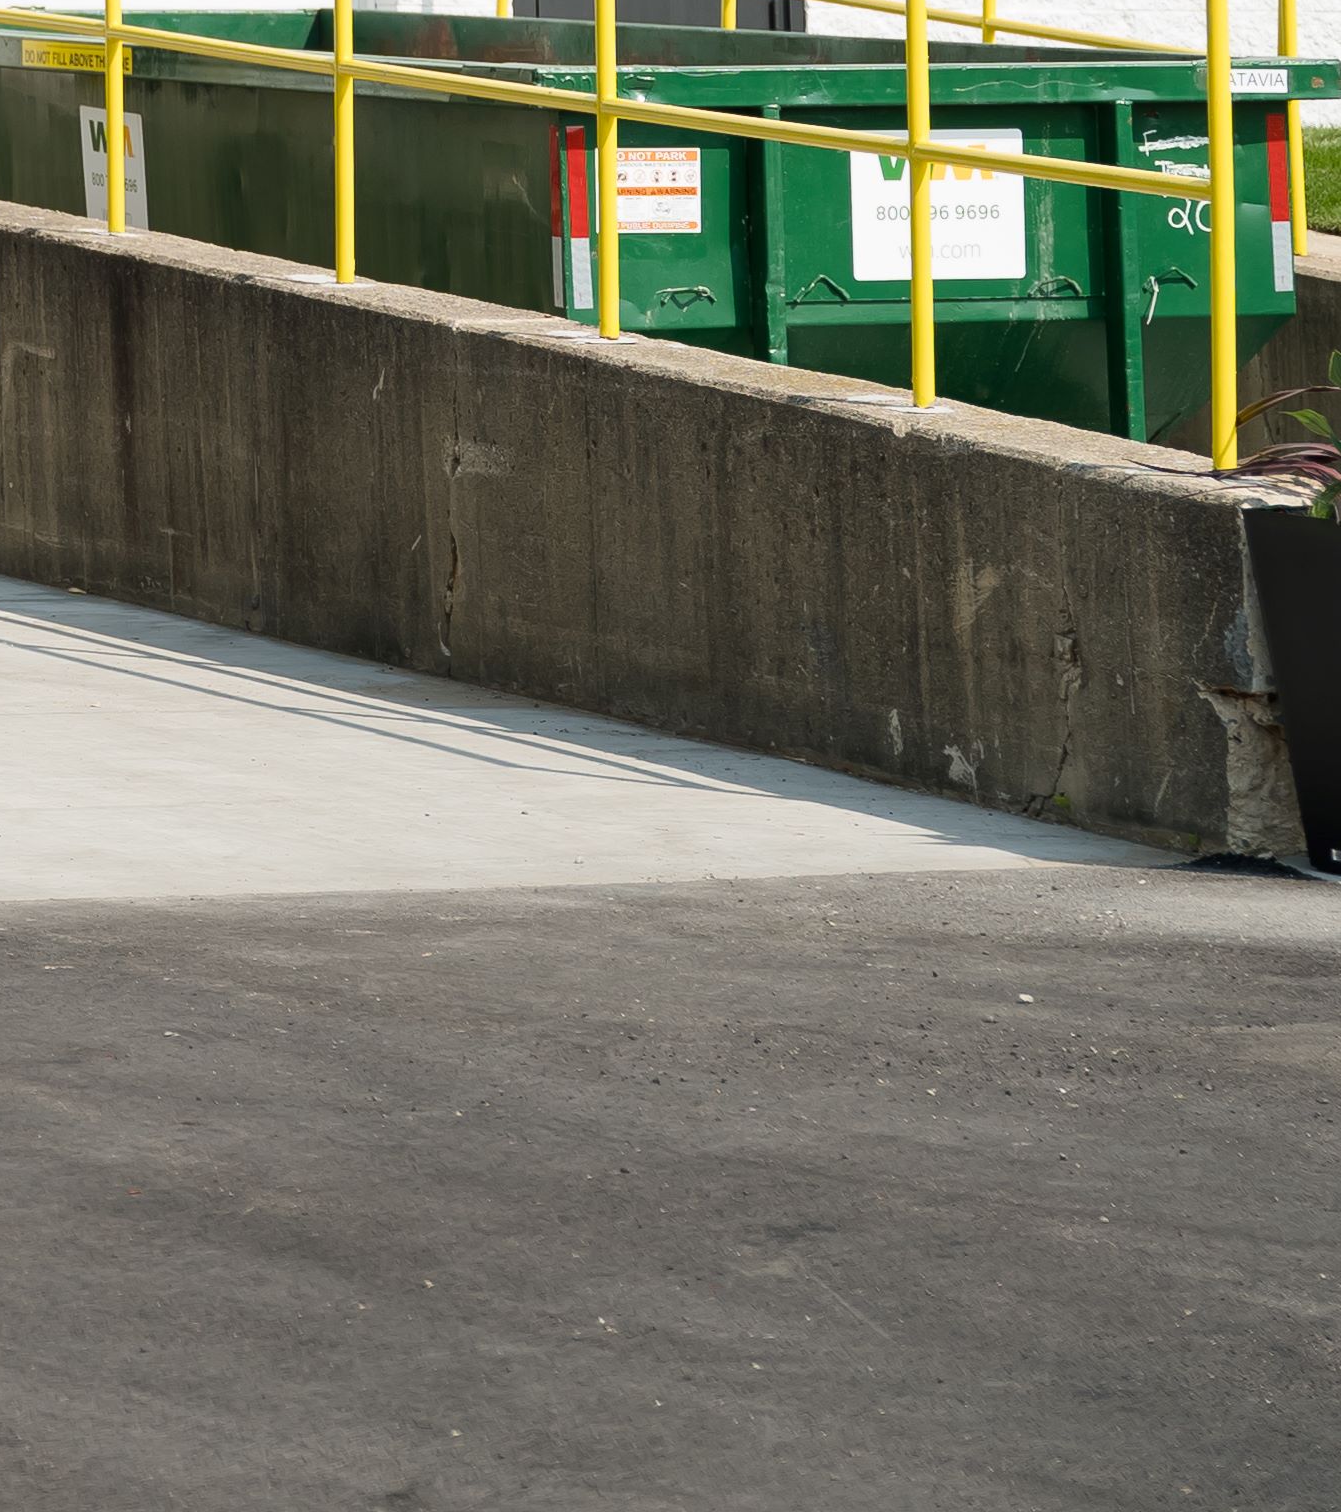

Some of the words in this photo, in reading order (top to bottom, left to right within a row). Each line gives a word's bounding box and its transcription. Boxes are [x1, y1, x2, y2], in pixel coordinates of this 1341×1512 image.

[24, 49, 36, 64] DO
[37, 50, 51, 65] NOT
[52, 52, 68, 67] FILL
[70, 52, 94, 69] ABOVE
[1231, 72, 1285, 87] ATAVIA
[628, 151, 652, 161] NOT
[654, 151, 687, 162] PARK
[876, 205, 910, 221] 800
[955, 204, 1000, 220] 9696
[898, 242, 981, 259] w.com
